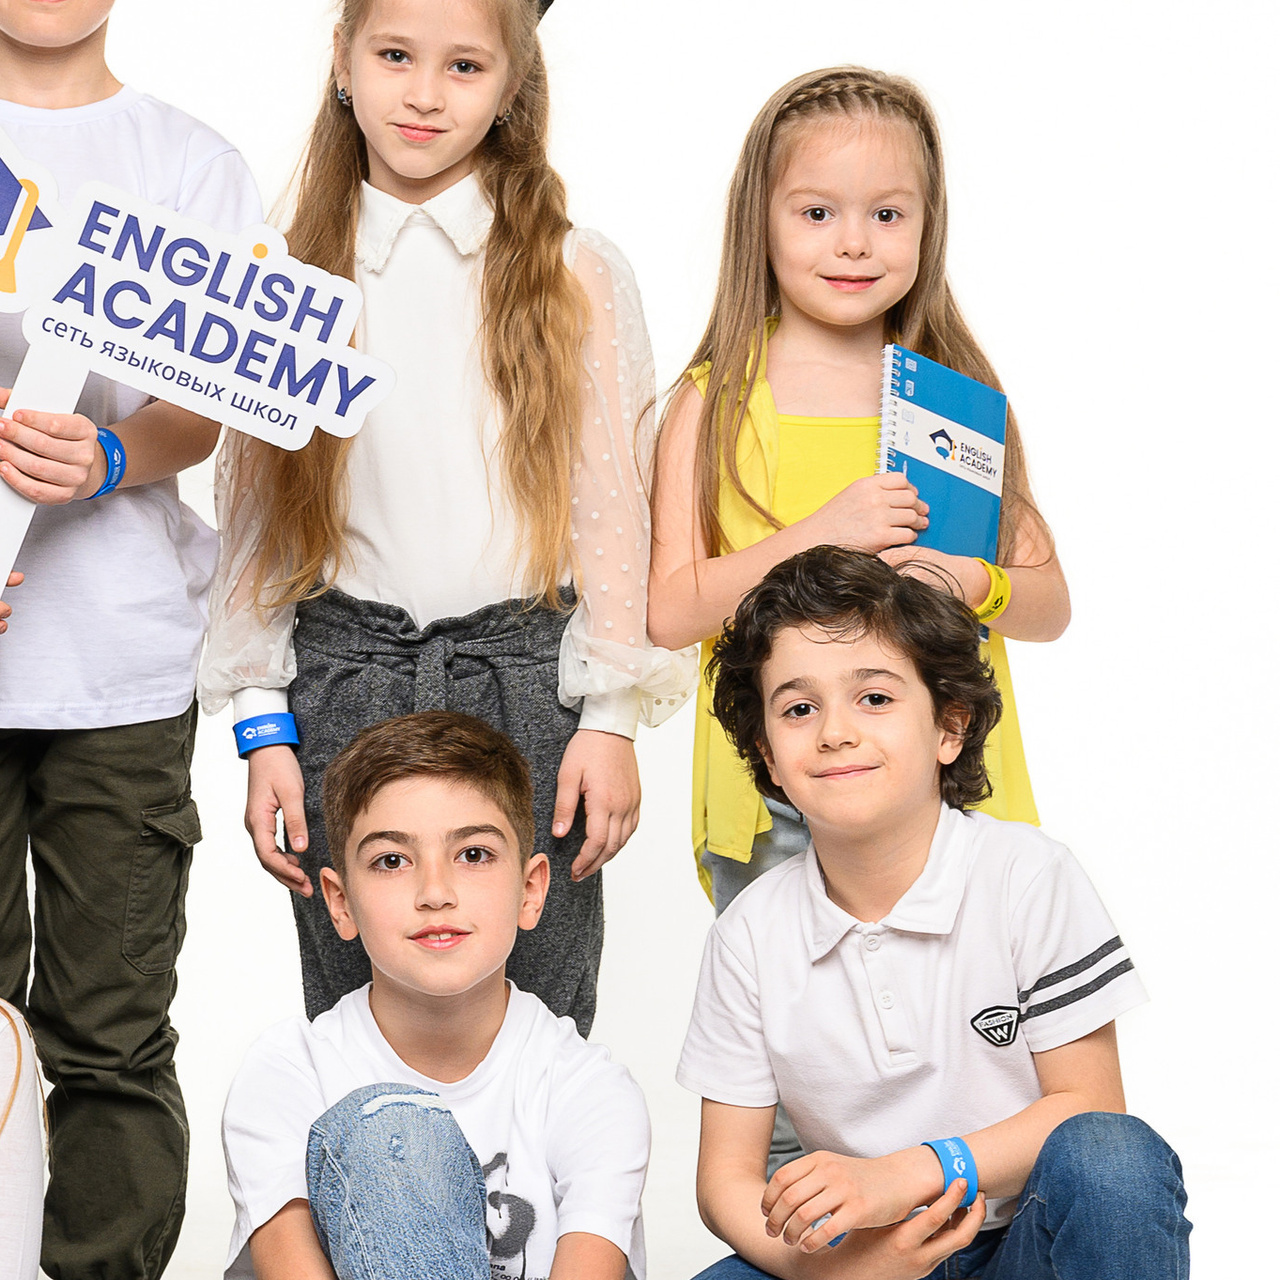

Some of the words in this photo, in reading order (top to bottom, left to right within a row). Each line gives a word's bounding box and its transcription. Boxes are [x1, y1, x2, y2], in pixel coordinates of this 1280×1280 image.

[52, 262, 376, 418] ACADEMY
[41, 317, 94, 349] сеть
[99, 340, 226, 402] языковых
[230, 391, 298, 431] школ
[960, 442, 992, 464] ENGLISH
[960, 454, 997, 477] ACADEMY
[979, 1013, 1013, 1028] FASHION
